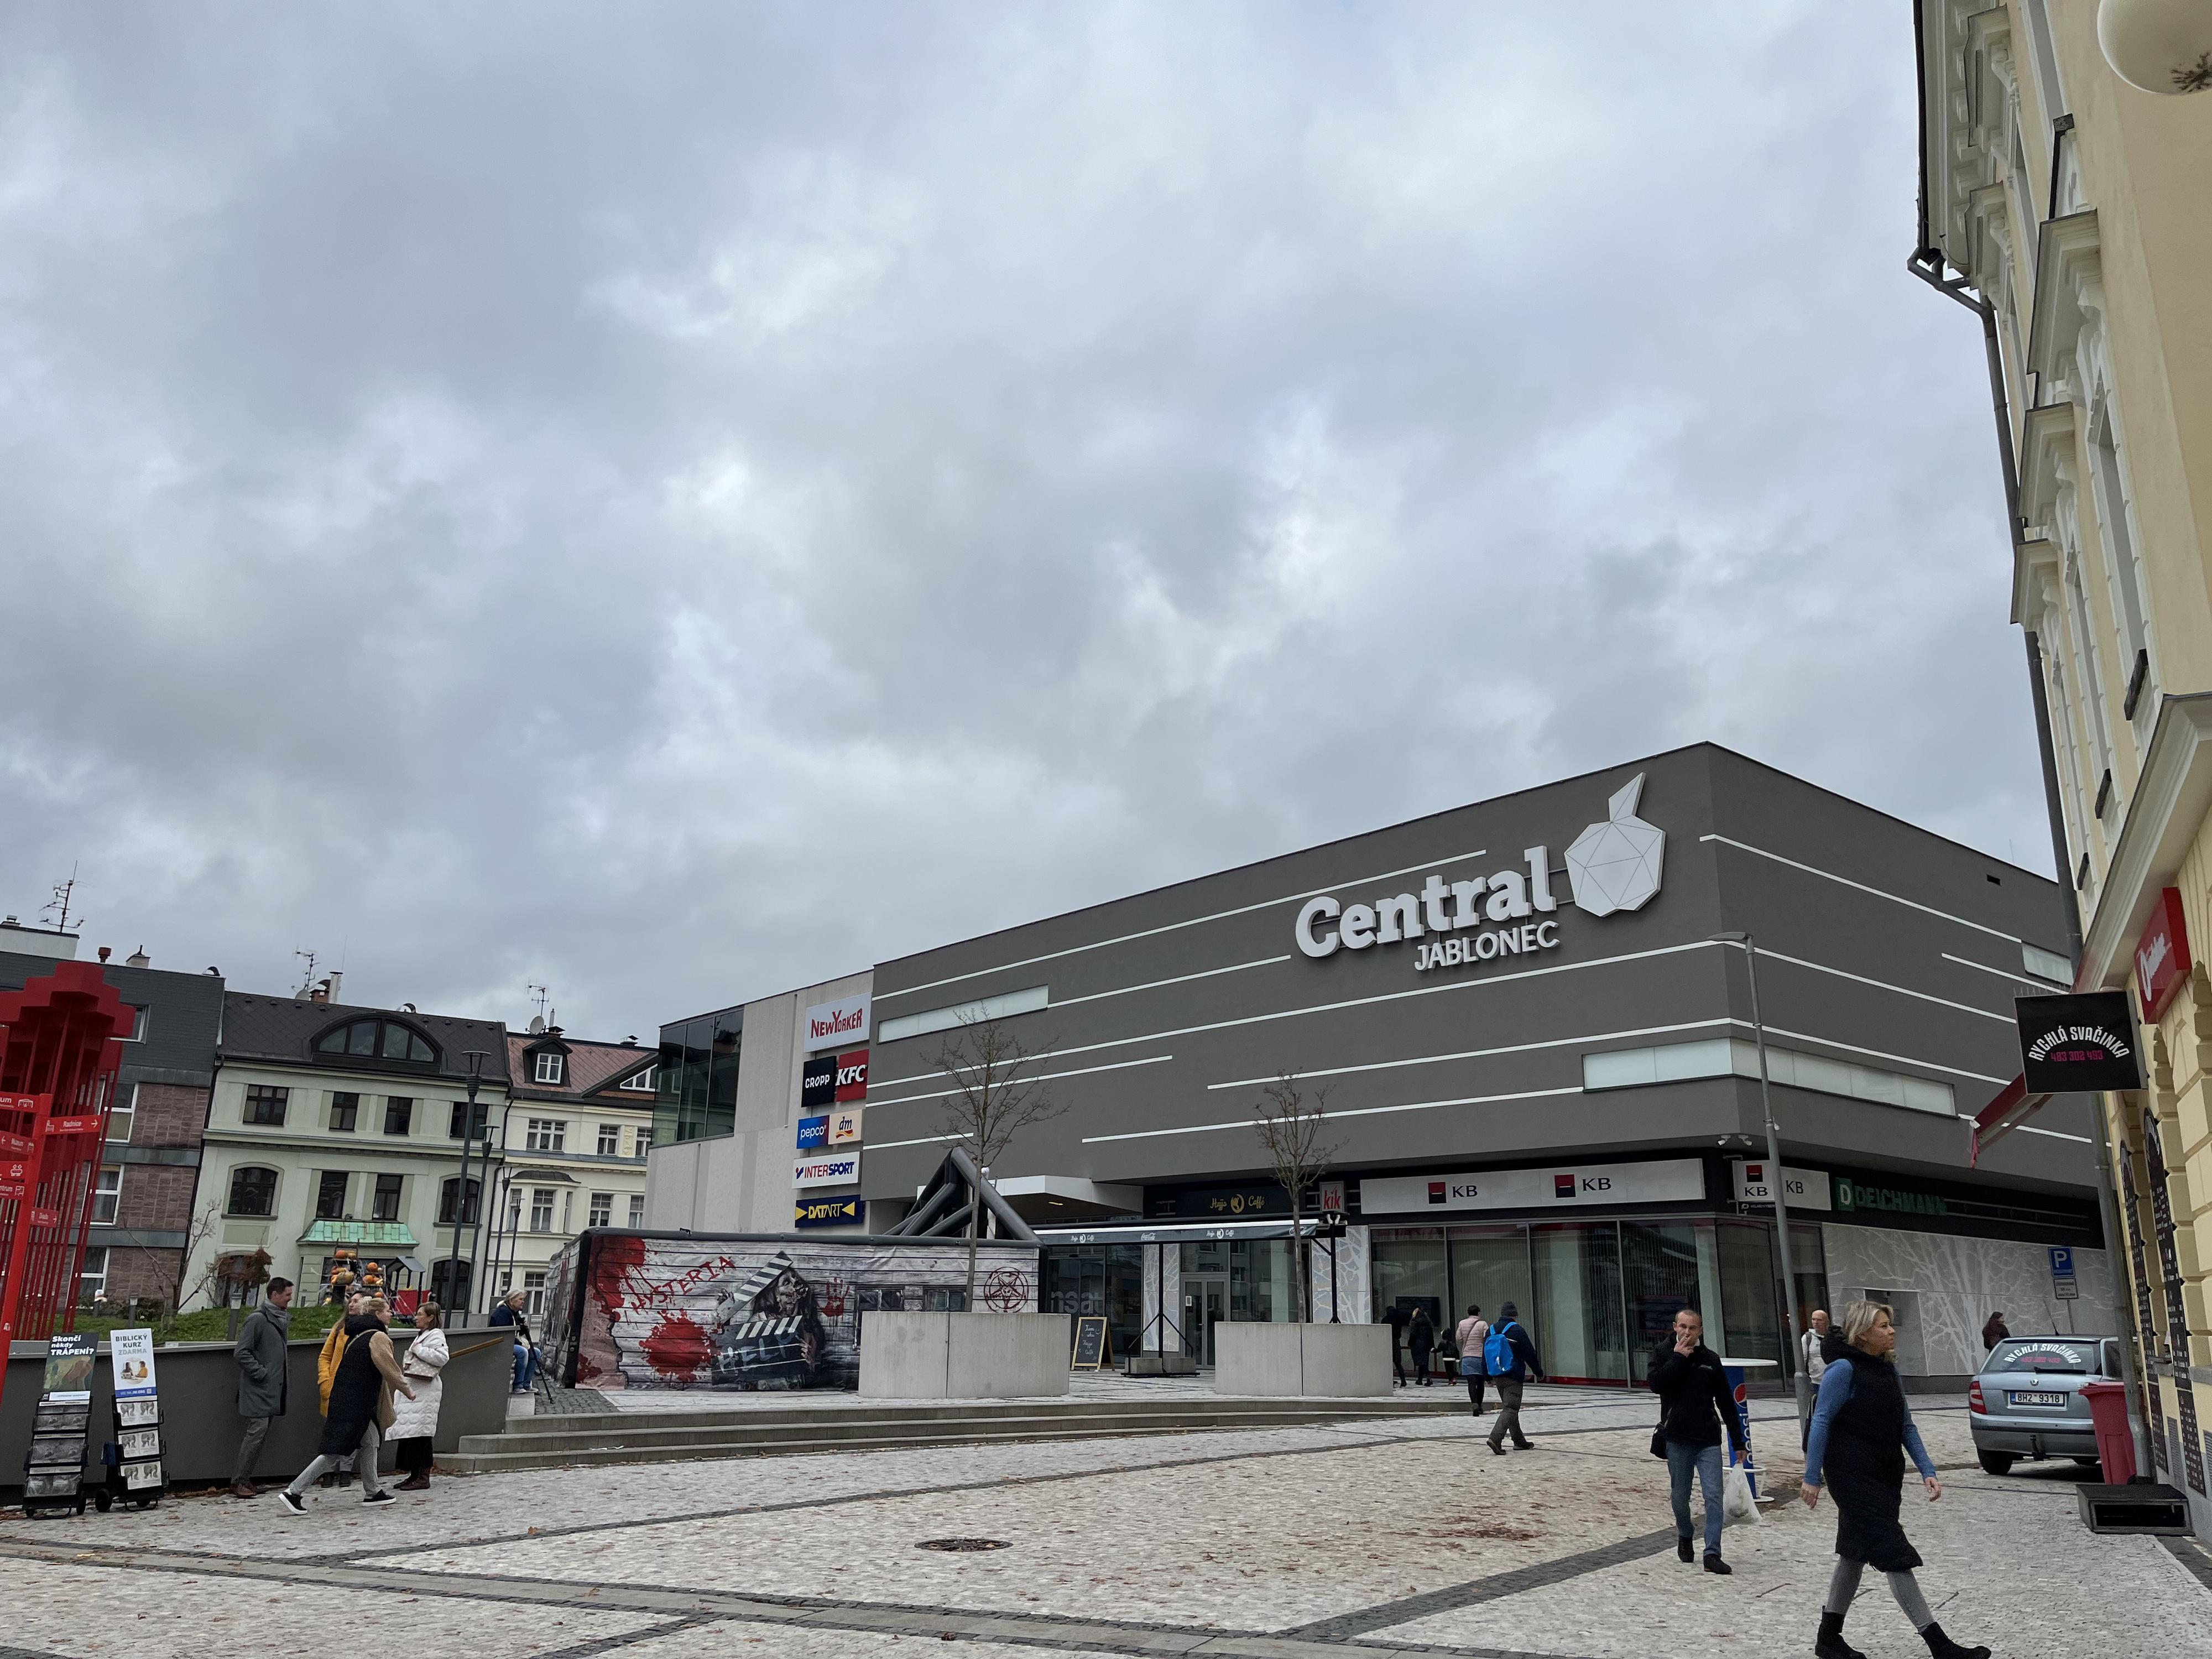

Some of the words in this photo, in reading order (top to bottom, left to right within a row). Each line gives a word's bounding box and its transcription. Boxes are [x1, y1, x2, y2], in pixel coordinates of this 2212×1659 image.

[1295, 845, 1557, 958] Central
[1415, 921, 1560, 971] JABLONEC
[2028, 1025, 2069, 1061] RYCHLÁ
[2070, 1026, 2130, 1058] SVAČINKA
[805, 1074, 830, 1089] CROPP
[835, 1064, 867, 1086] KFC
[839, 1116, 853, 1130] dm
[800, 1126, 825, 1141] pepco
[805, 1162, 854, 1184] INTERSPORT
[1452, 1185, 1478, 1198] KB
[1582, 1177, 1611, 1191] KB
[1745, 1187, 1768, 1196] KB
[1786, 1180, 1804, 1194] KB
[1323, 1186, 1341, 1210] kik
[808, 1203, 843, 1219] DATART
[2053, 1250, 2067, 1268] P
[630, 1256, 737, 1315] HYSTERIA
[50, 1347, 95, 1355] TRÁPENÍ?
[718, 1327, 797, 1376] HELP
[2004, 1343, 2038, 1363] RYCHLÁ
[2041, 1343, 2081, 1364] SVAČINKA
[2017, 1393, 2032, 1402] 8H2
[2039, 1394, 2060, 1403] 9318
